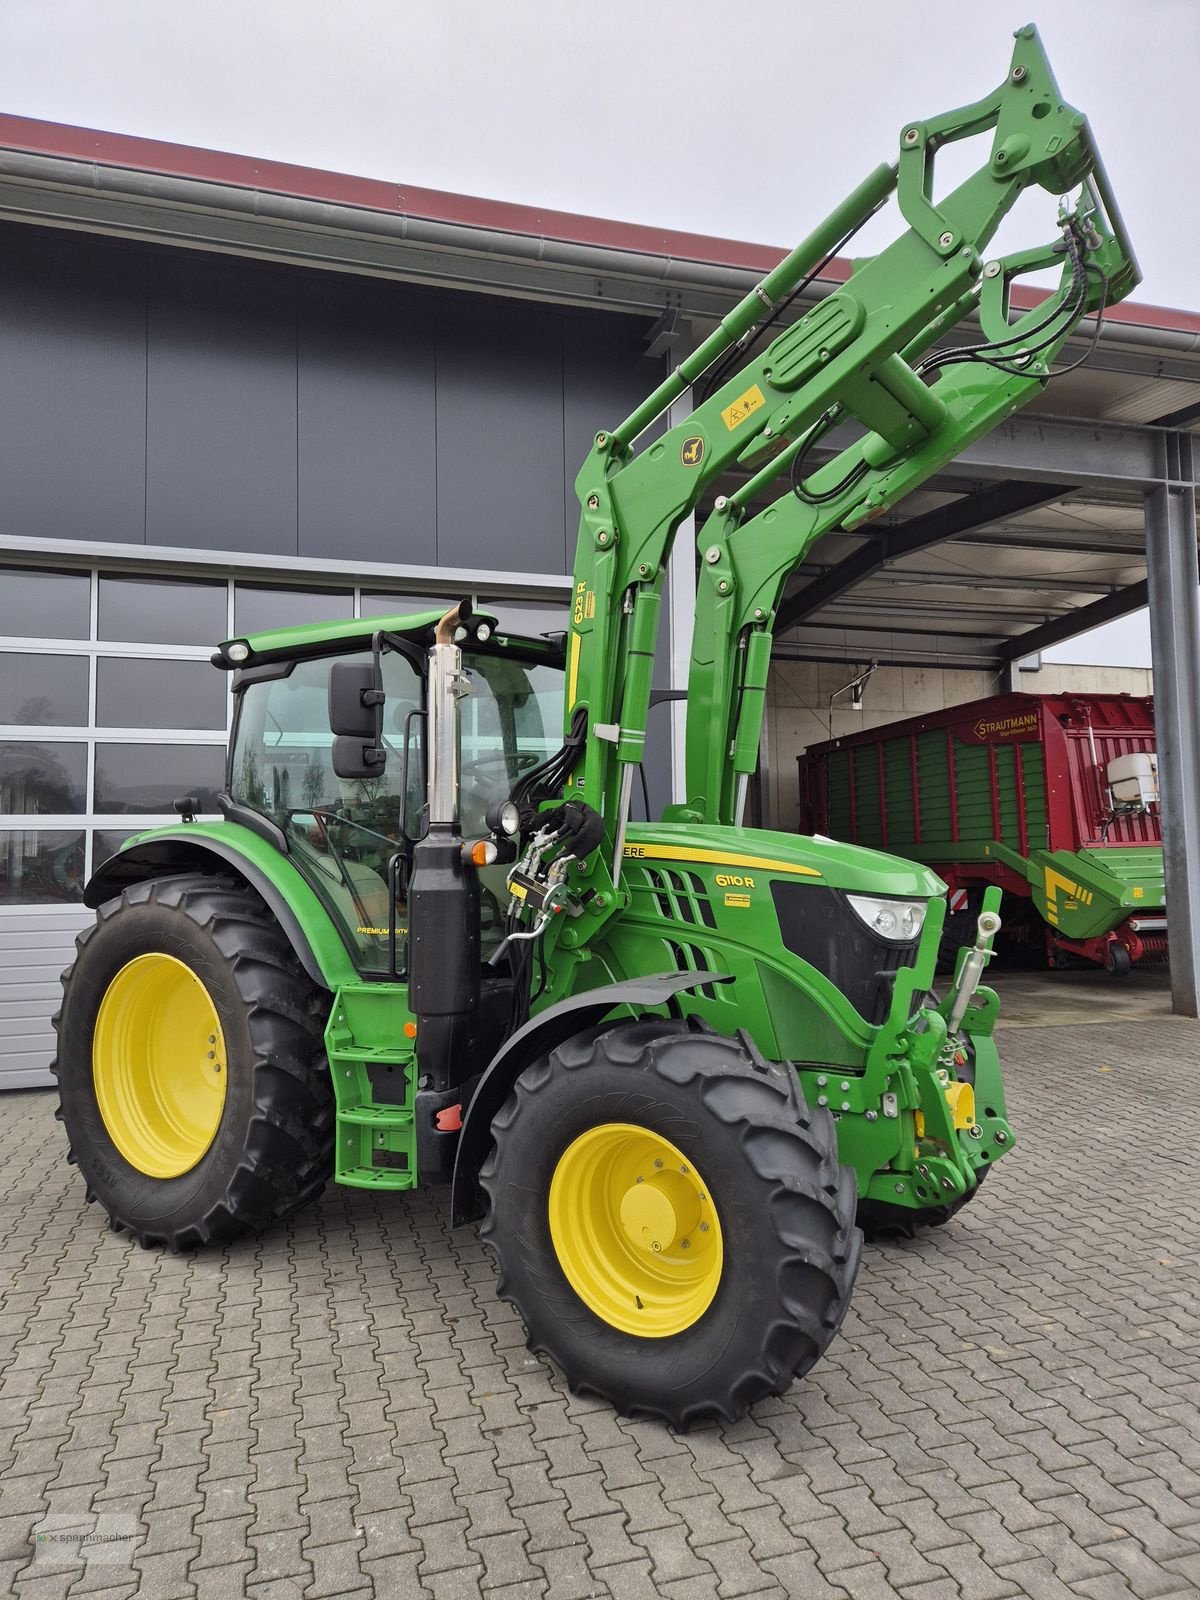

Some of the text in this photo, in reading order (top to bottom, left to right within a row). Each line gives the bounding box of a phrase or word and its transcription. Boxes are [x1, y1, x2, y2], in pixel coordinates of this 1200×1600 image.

[574, 580, 588, 624] 623 R
[979, 714, 1038, 735] STRAUTMANN
[715, 874, 756, 888] 6110 R
[356, 927, 390, 935] PREMIUM
